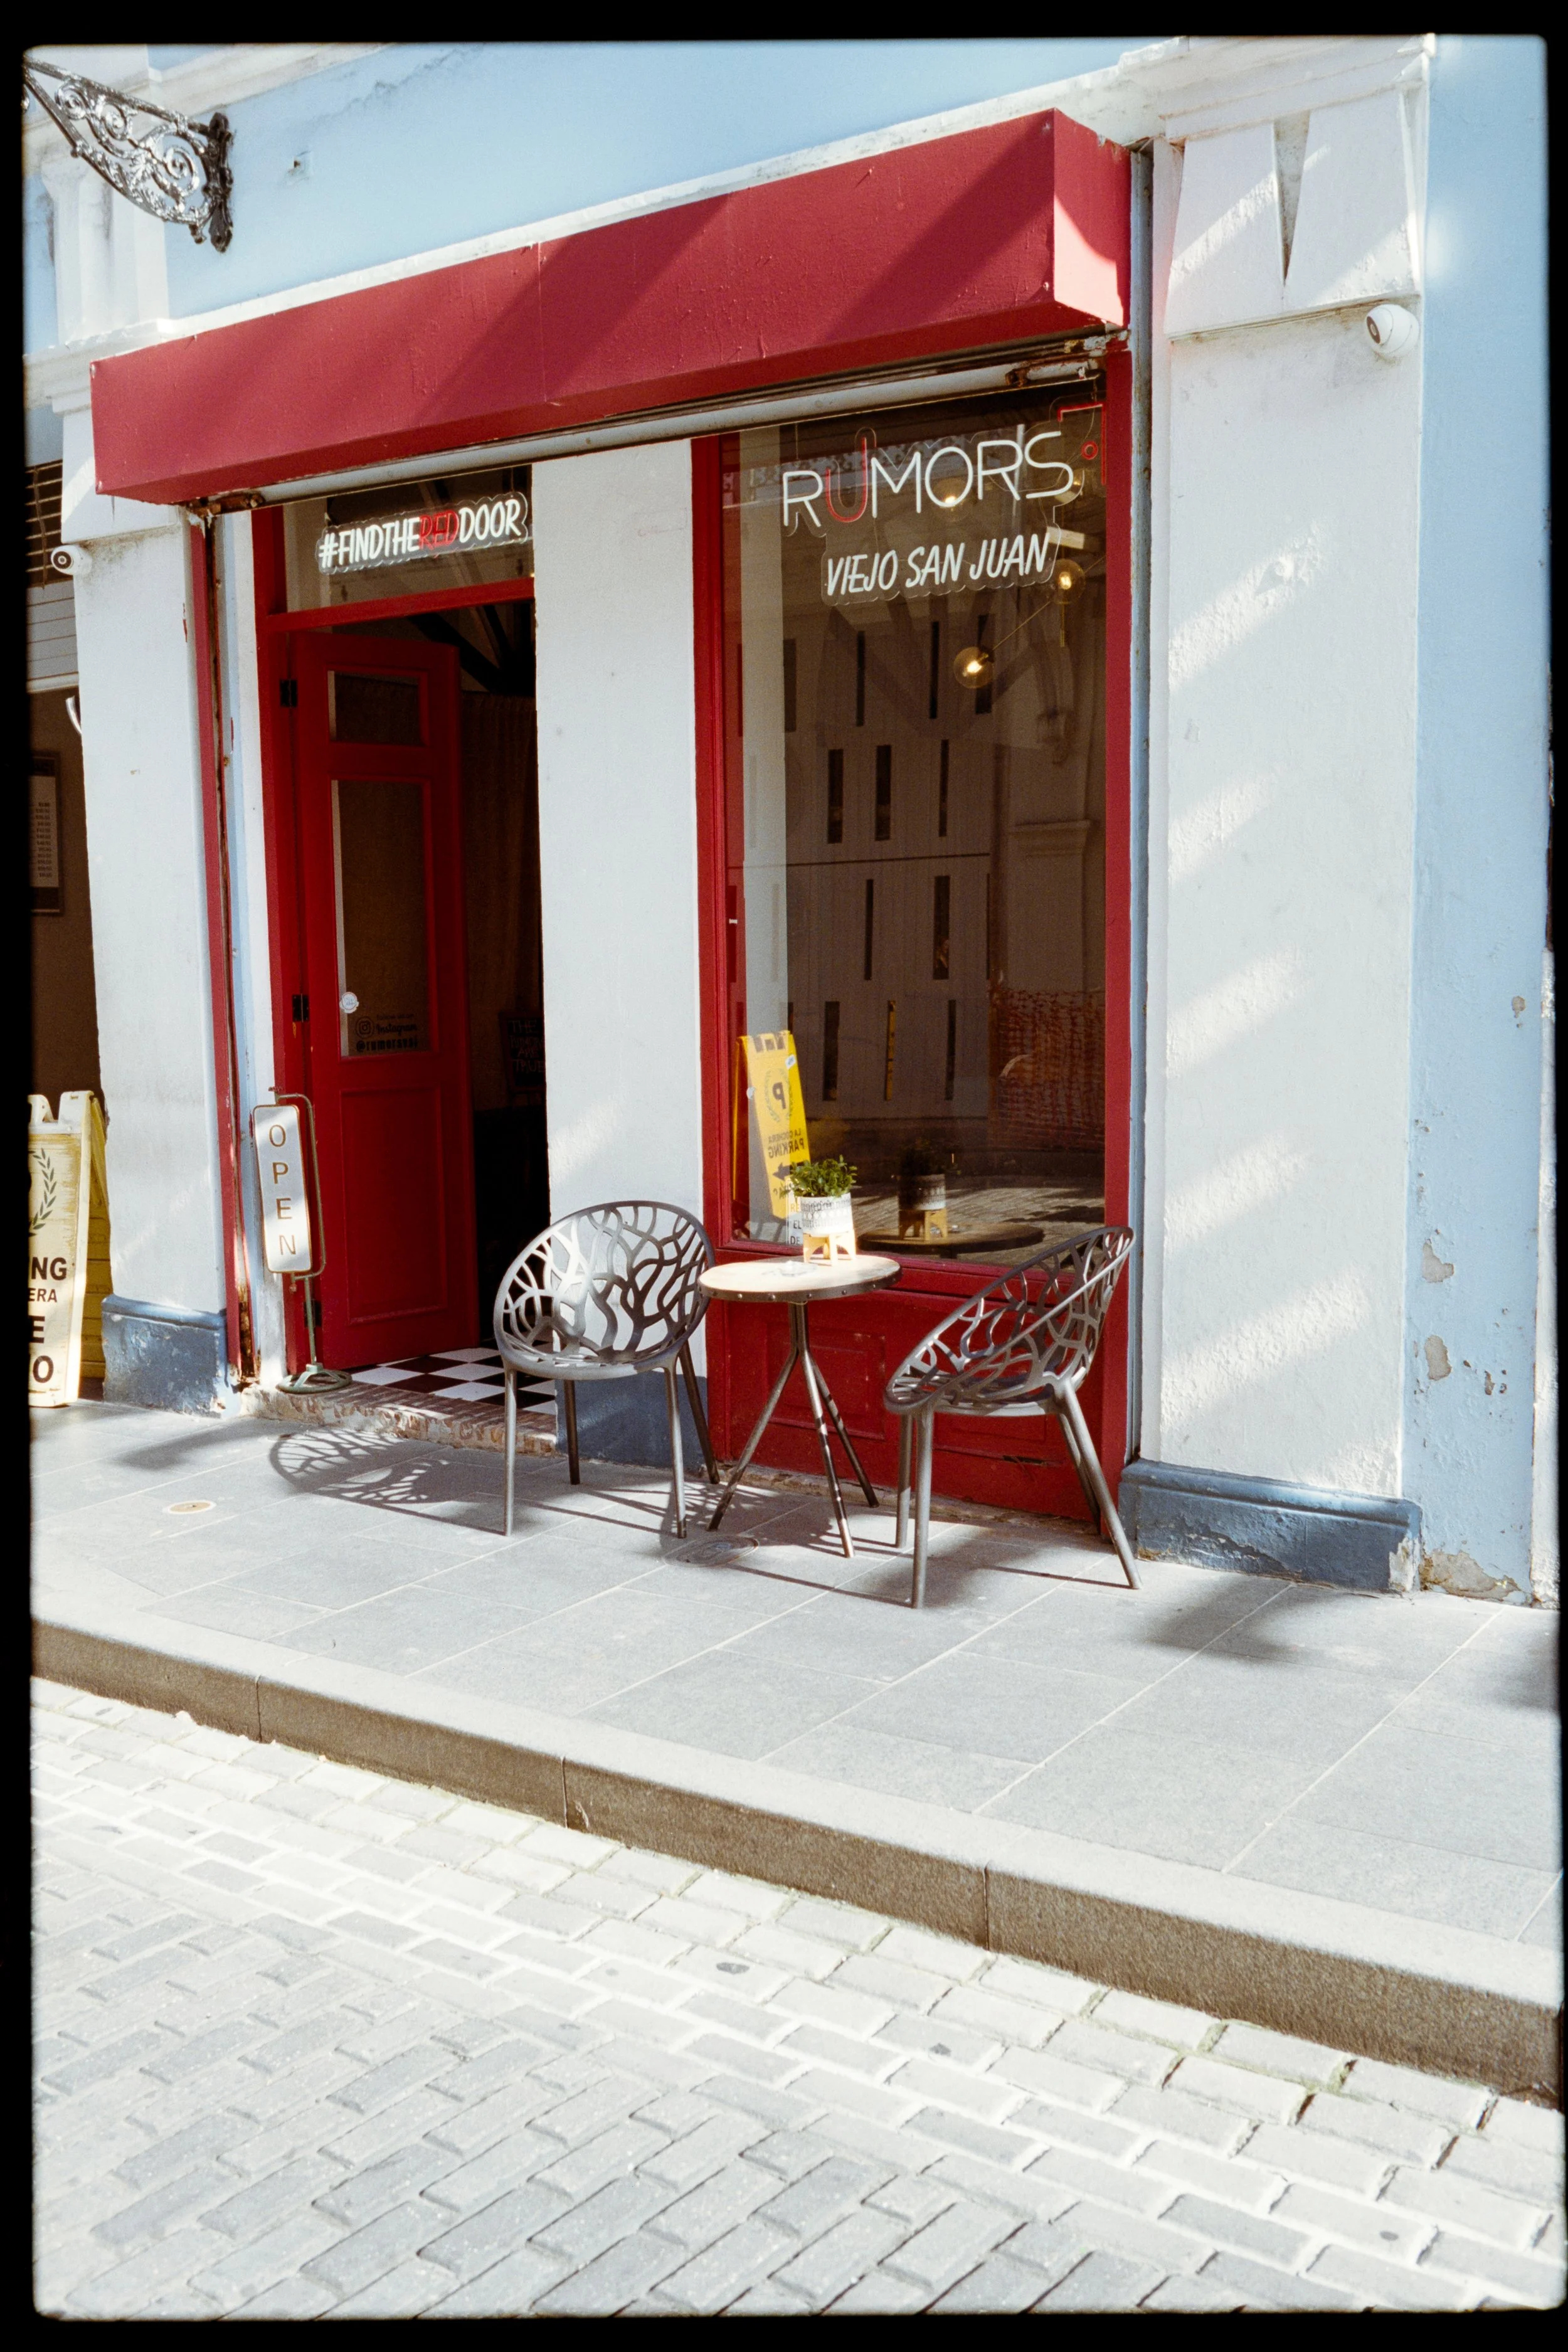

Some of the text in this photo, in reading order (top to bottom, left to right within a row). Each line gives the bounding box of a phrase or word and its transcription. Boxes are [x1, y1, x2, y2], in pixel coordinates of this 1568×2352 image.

[783, 430, 1074, 527] RUMORS
[827, 533, 1051, 596] VIEJO SAN JUAN
[269, 1125, 297, 1256] OPEN
